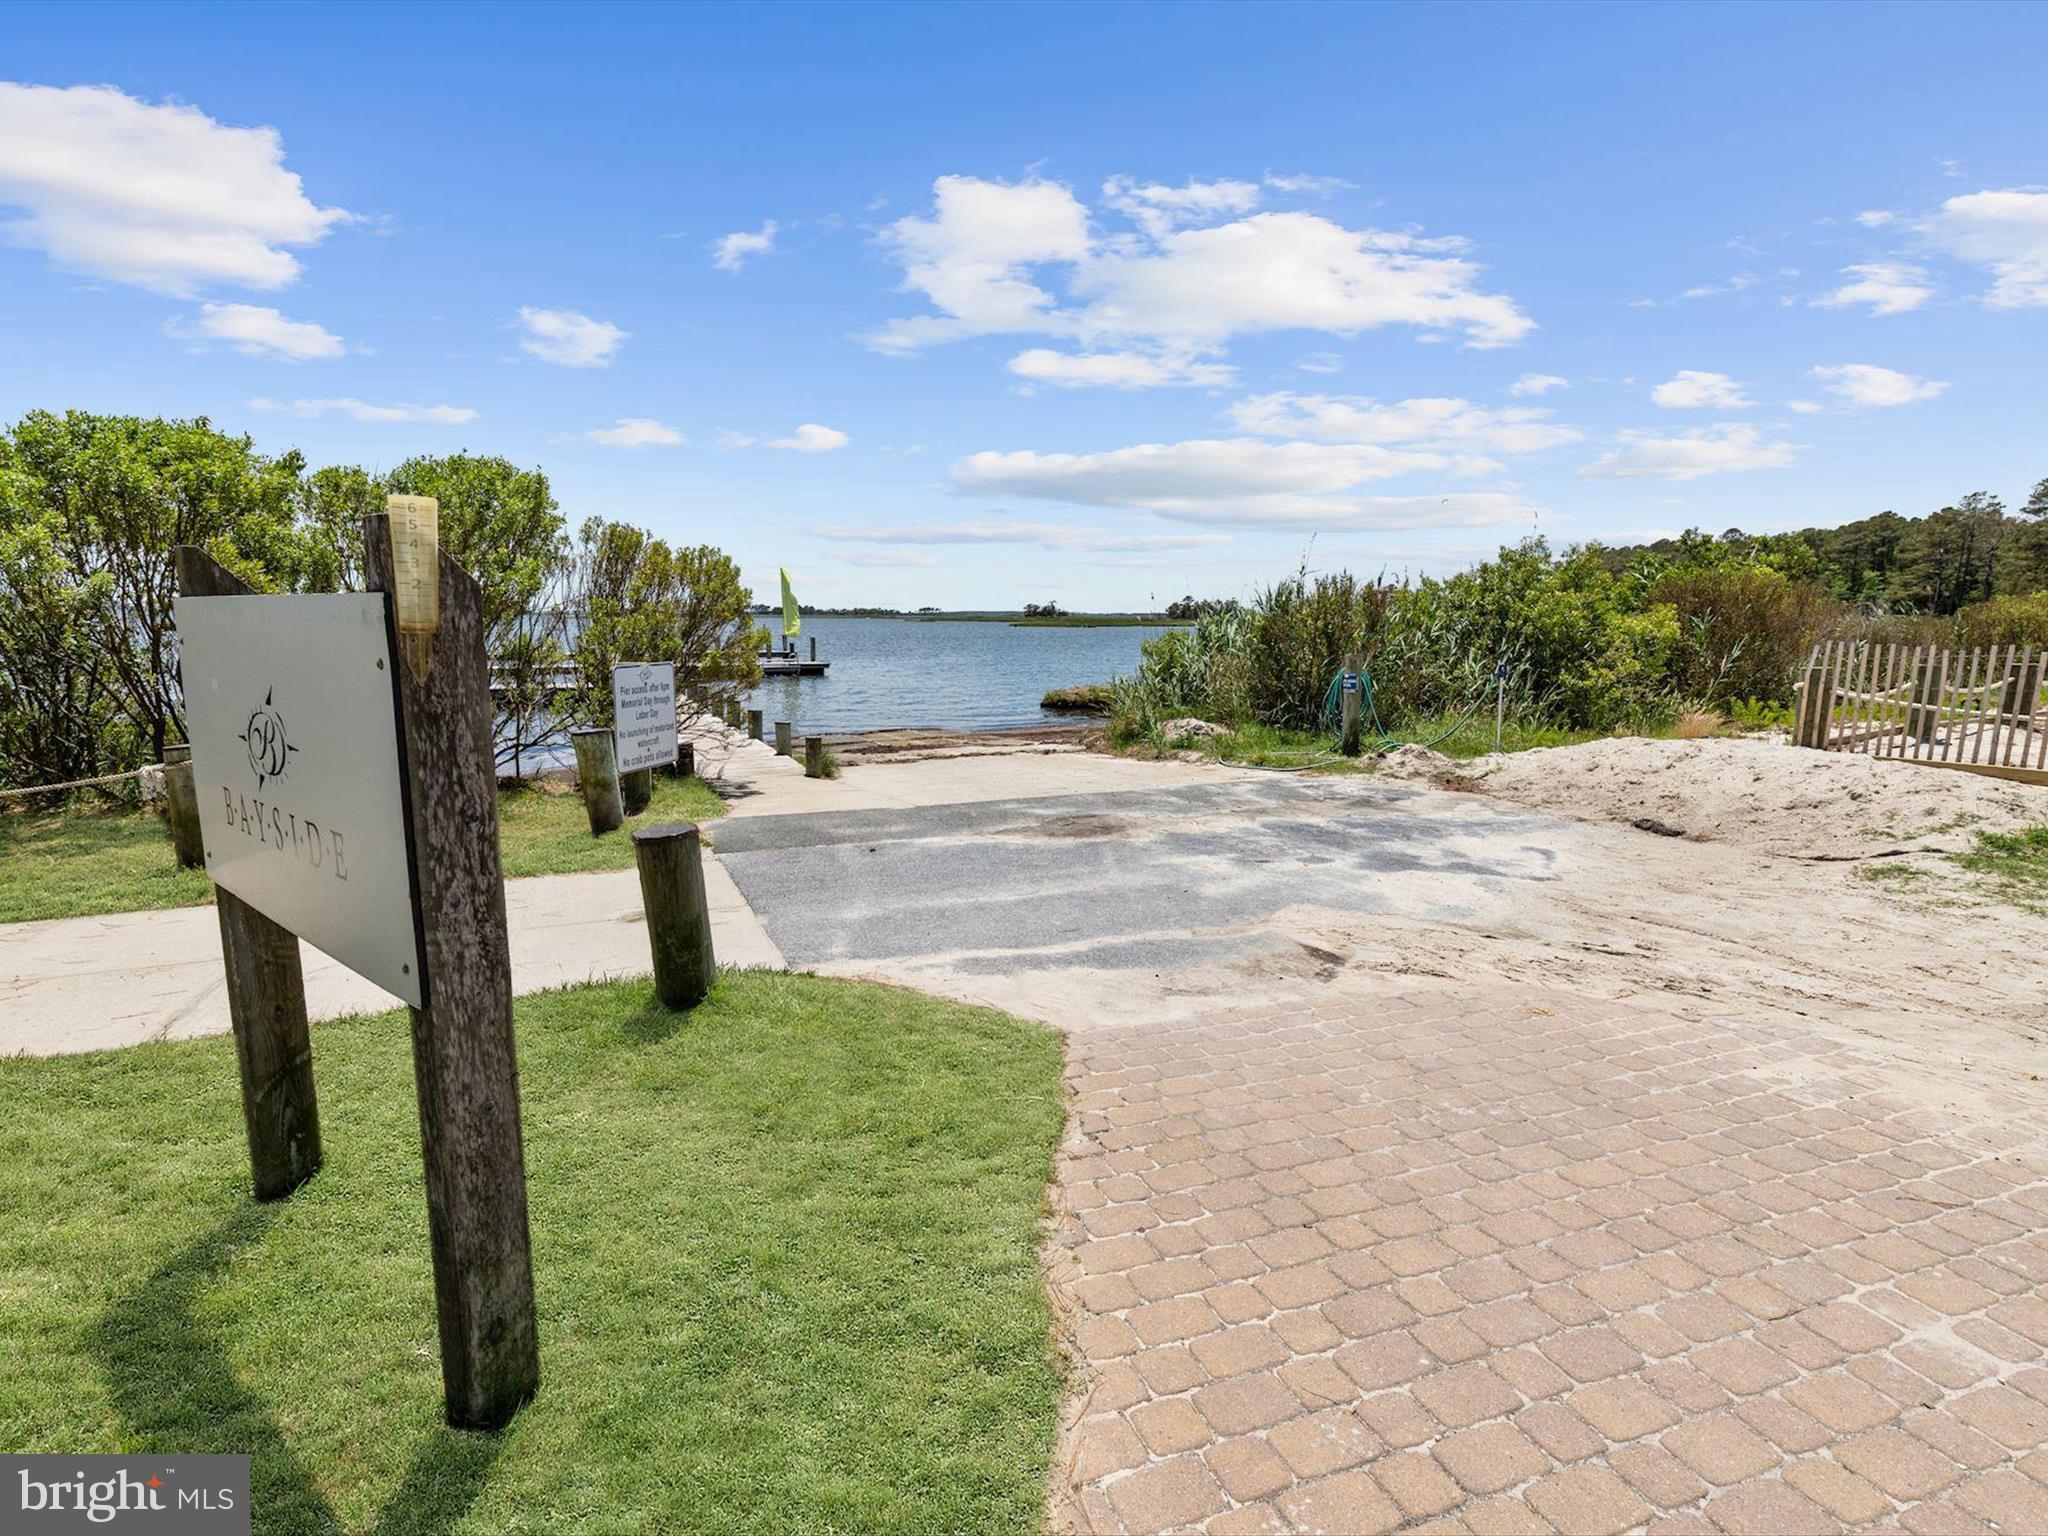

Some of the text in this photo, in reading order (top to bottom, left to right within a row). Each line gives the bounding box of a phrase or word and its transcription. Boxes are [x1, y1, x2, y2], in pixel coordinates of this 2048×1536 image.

[408, 503, 417, 514] 6
[409, 519, 418, 530] 5
[409, 539, 418, 549] 4
[410, 558, 420, 568] 3
[412, 579, 421, 590] 2
[620, 686, 630, 696] Pier
[631, 686, 648, 695] access
[649, 683, 659, 693] after
[621, 696, 670, 708] Memorial Day through
[636, 709, 659, 720] Labor Day
[619, 722, 675, 739] No launching of motorized
[638, 736, 659, 748] watercraft
[623, 749, 673, 767] No crab pots allowed
